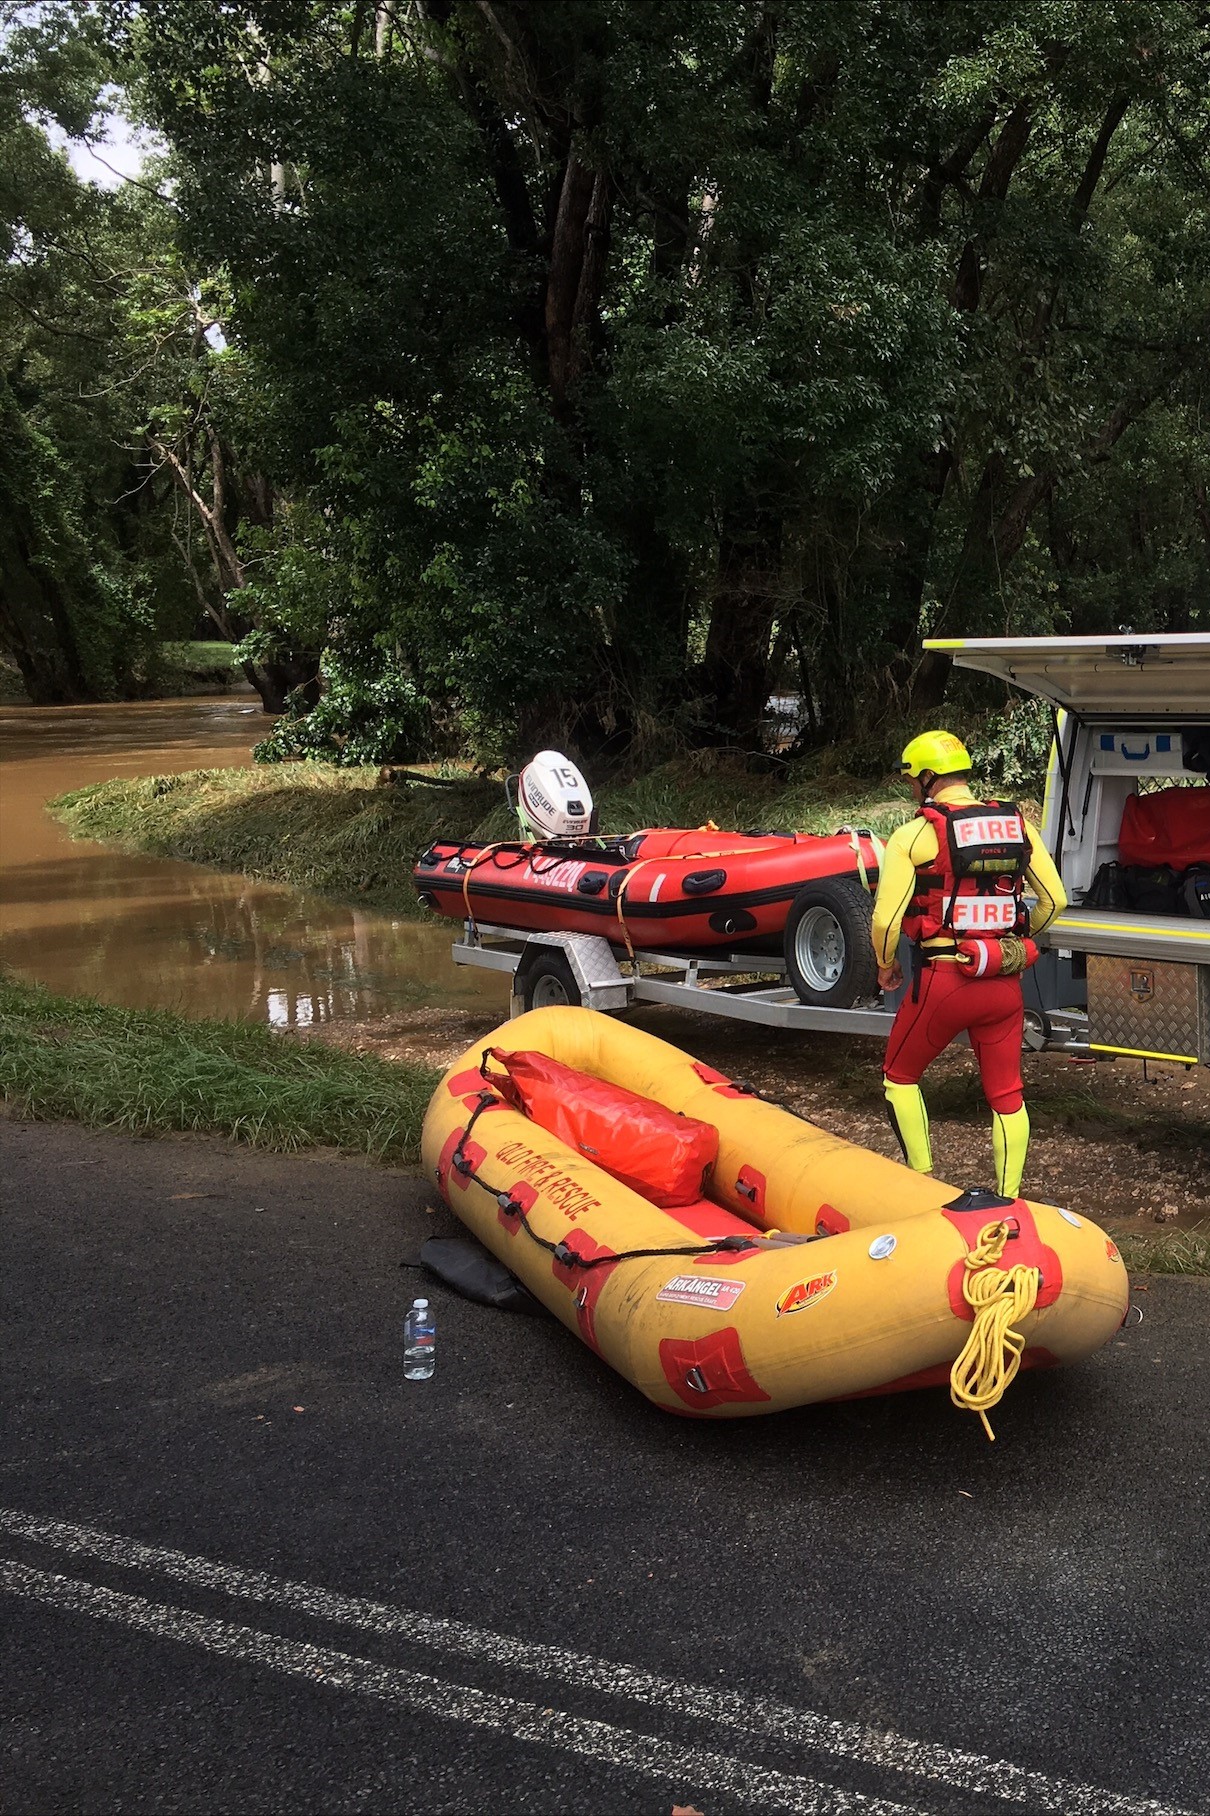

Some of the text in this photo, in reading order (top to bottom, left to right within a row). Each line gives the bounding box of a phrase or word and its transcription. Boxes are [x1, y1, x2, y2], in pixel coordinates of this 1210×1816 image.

[549, 767, 579, 788] 15
[525, 774, 556, 817] EVINRUDE
[958, 819, 1019, 843] FIRE
[953, 903, 1014, 923] FIRE
[496, 1142, 534, 1166] QLD
[512, 1154, 557, 1182] FIRE
[540, 1176, 602, 1222] RESCUE
[665, 1277, 721, 1296] ARKANGEL
[780, 1273, 835, 1315] ARK
